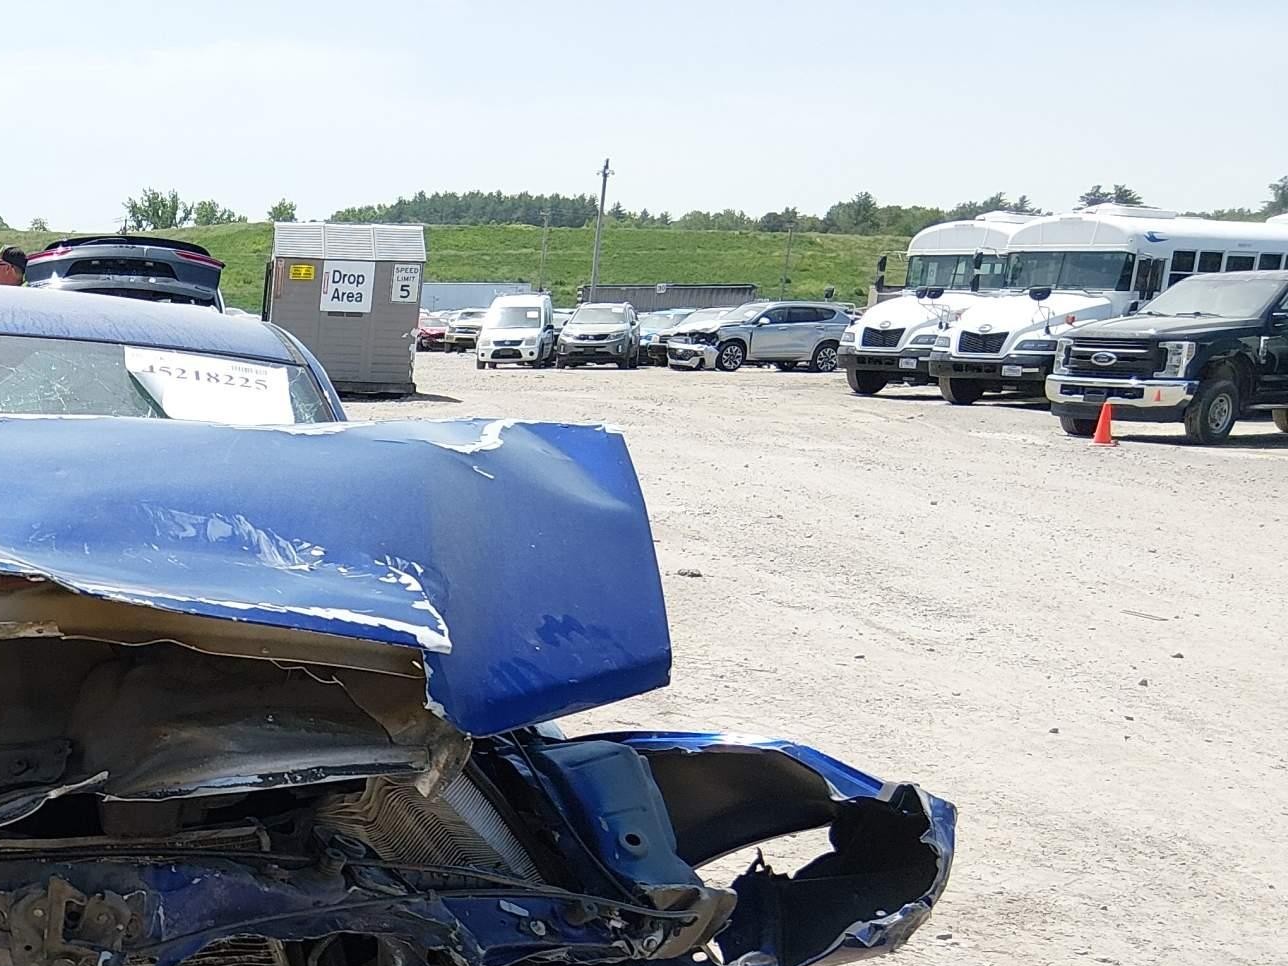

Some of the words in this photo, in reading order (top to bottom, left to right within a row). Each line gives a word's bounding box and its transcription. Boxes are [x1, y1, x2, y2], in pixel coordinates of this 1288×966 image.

[332, 269, 365, 287] Drop
[331, 287, 363, 303] Area
[399, 284, 411, 299] 5
